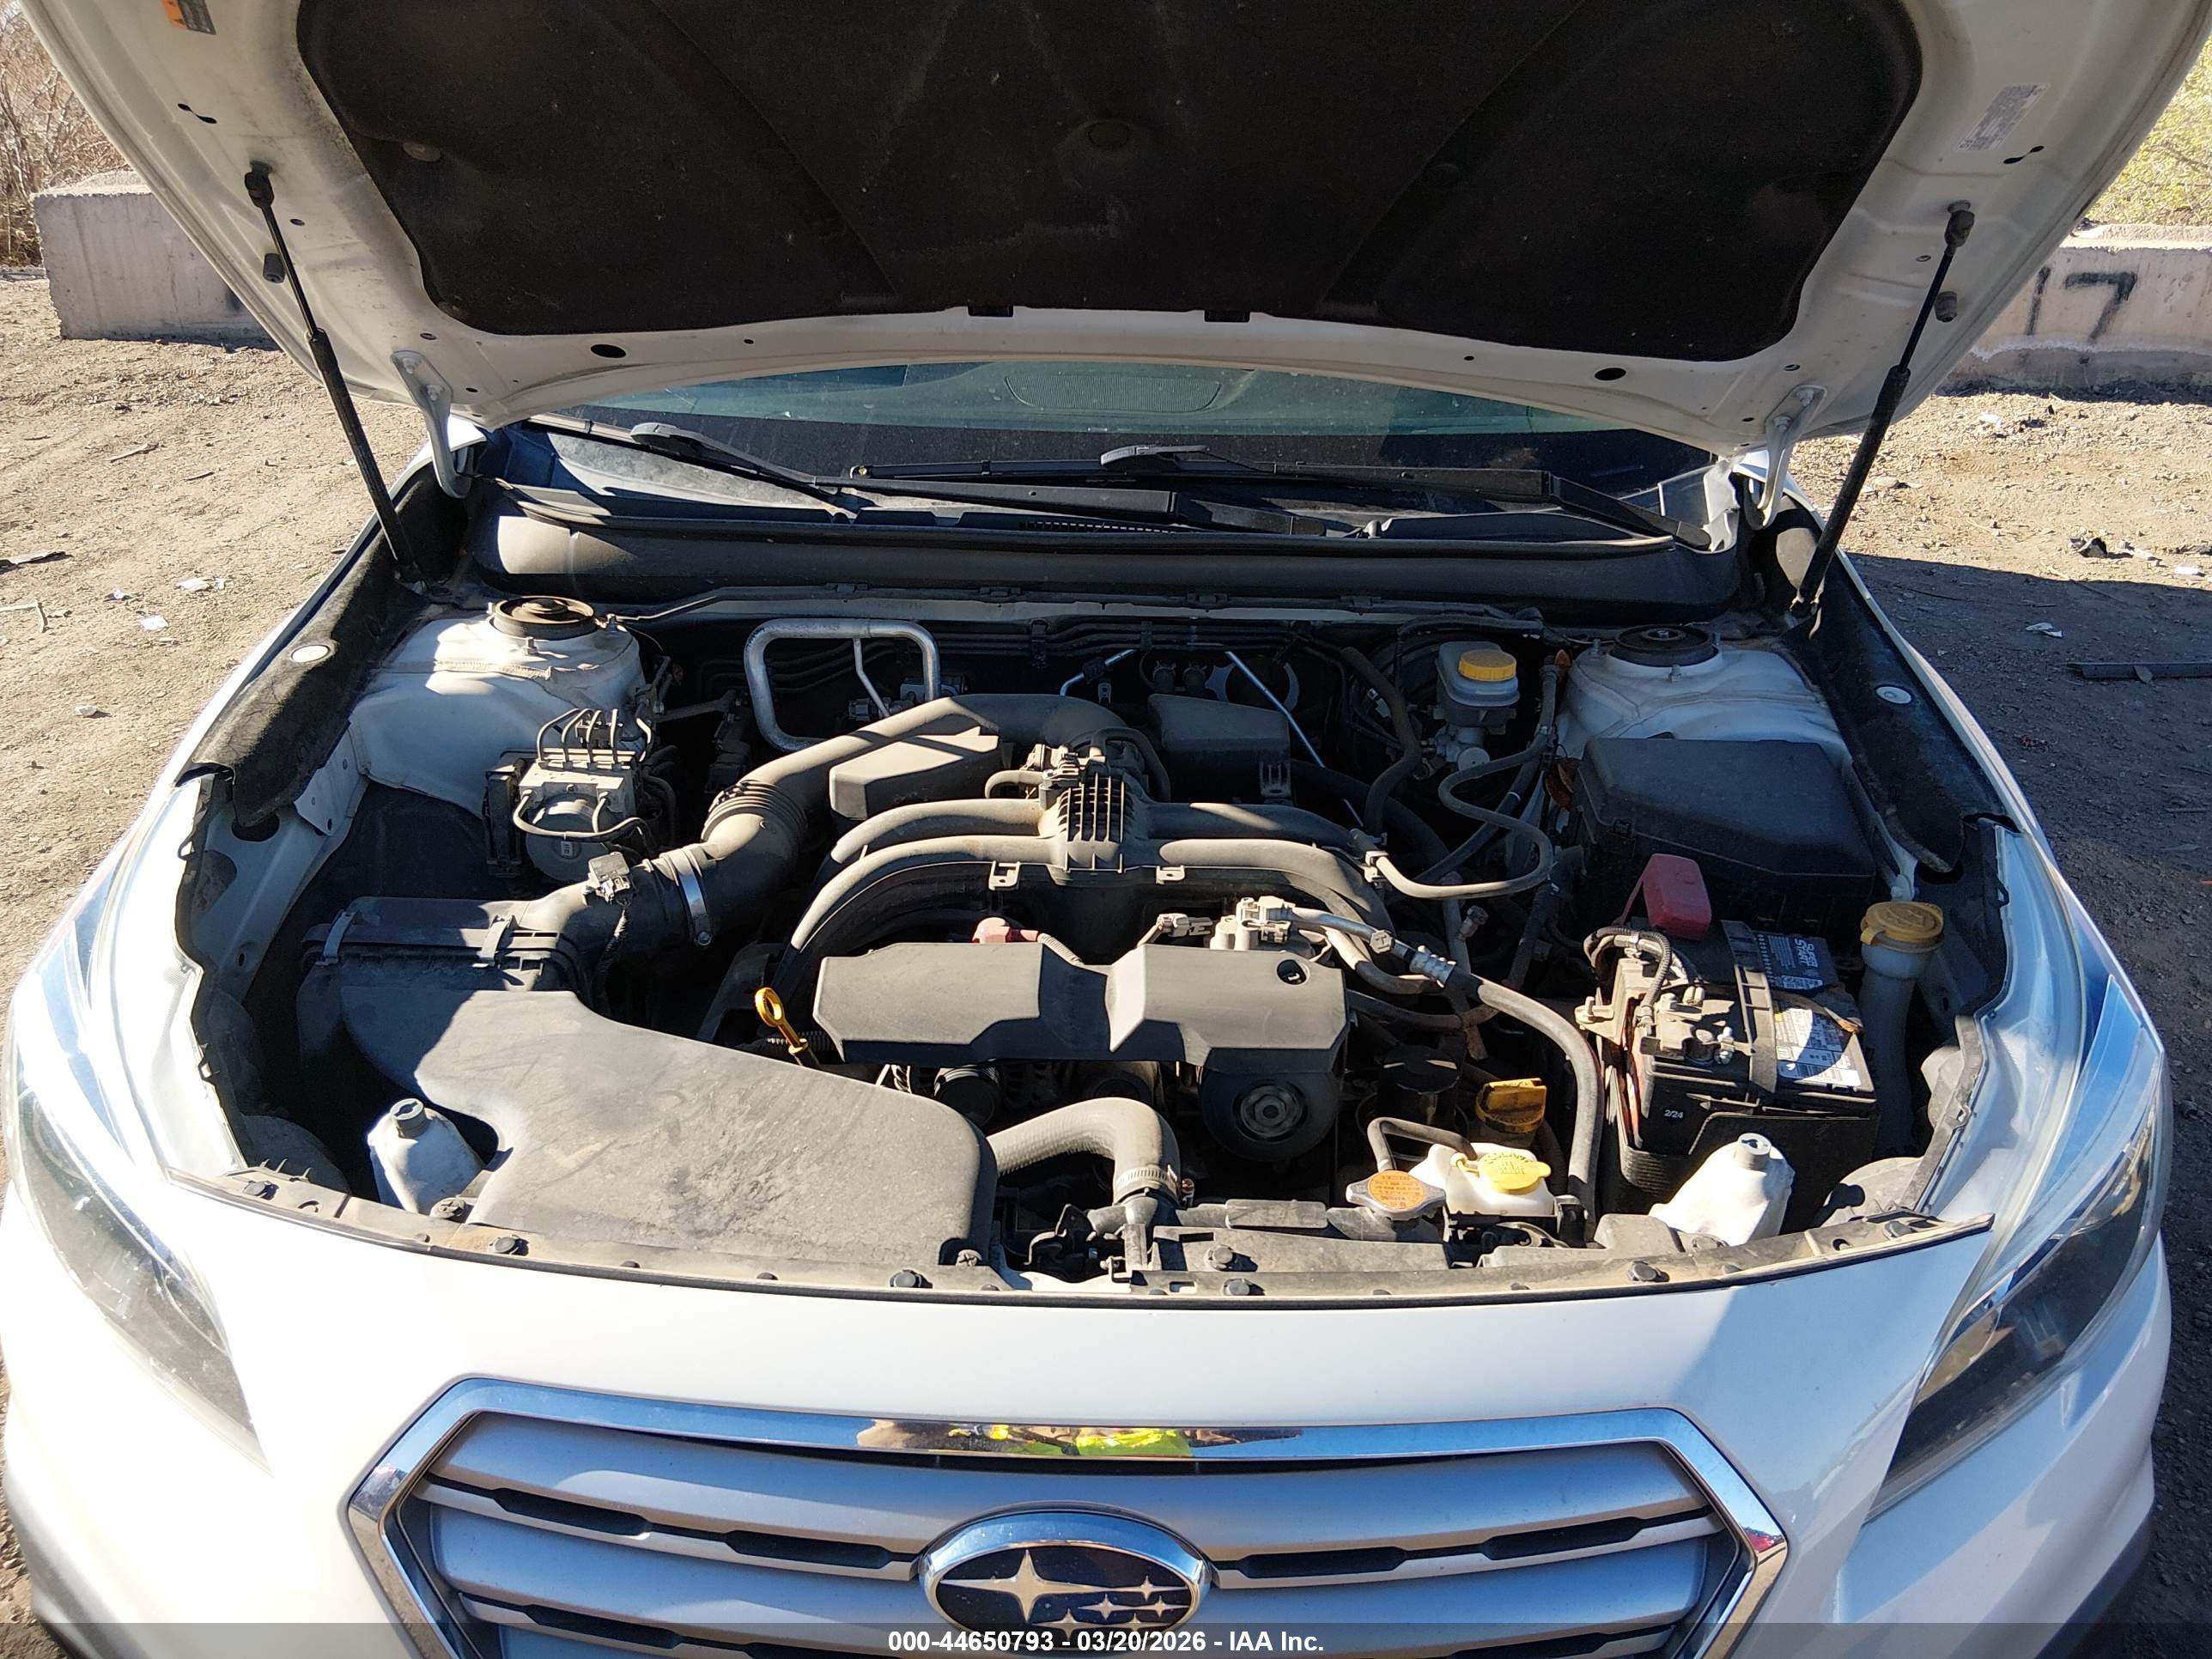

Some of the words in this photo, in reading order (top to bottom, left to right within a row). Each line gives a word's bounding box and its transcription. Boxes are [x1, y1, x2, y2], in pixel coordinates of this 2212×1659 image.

[2026, 266, 2138, 344] 17
[1794, 938, 1808, 963] START
[1663, 1109, 1684, 1119] 2/24
